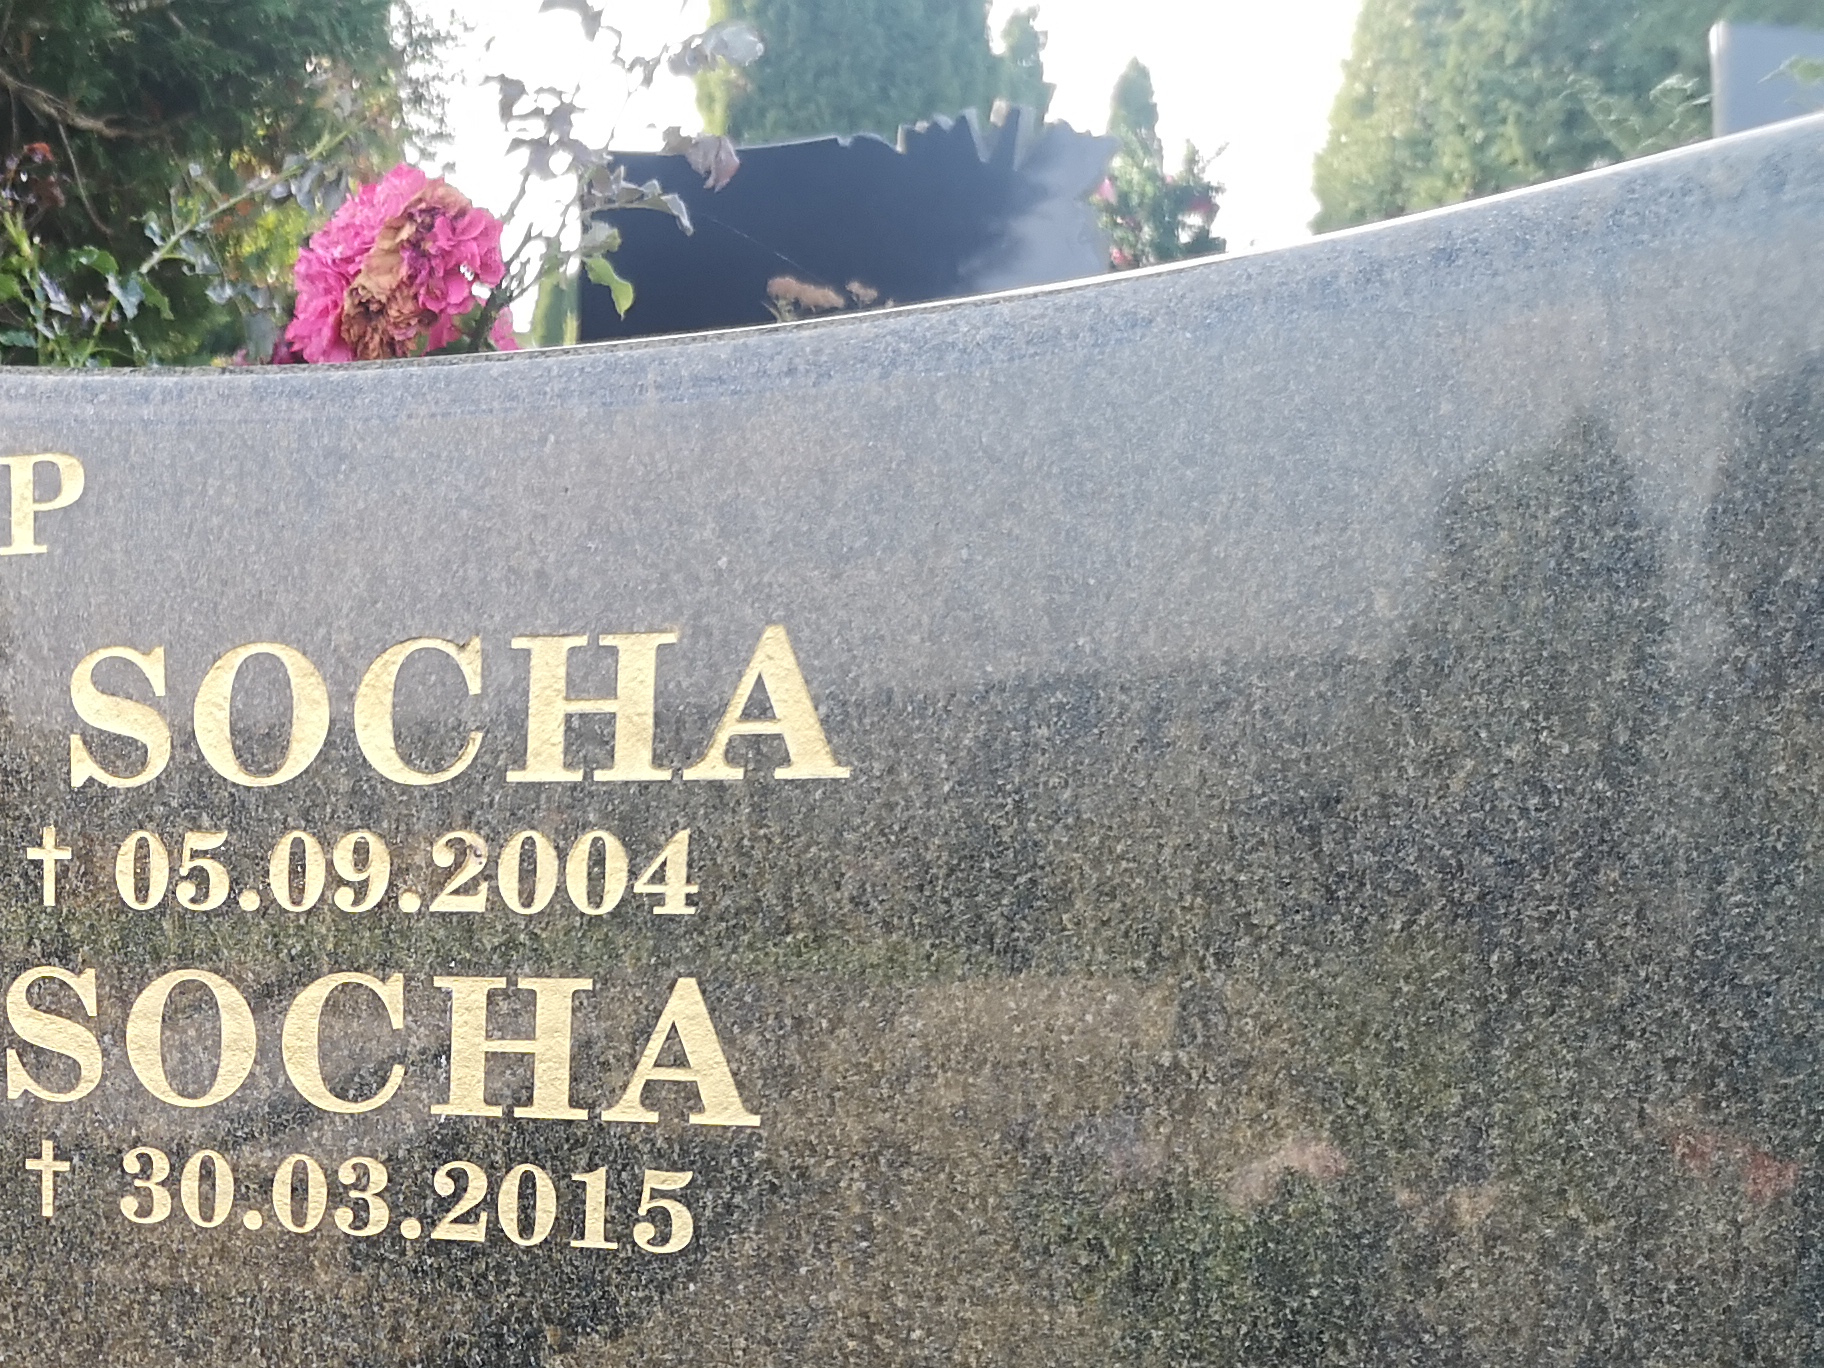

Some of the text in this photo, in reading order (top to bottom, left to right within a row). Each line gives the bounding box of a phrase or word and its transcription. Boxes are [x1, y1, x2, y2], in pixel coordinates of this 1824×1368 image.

[69, 624, 852, 788] SOCHA
[114, 827, 700, 916] 05.09.2004
[5, 965, 762, 1127] SOCHA
[120, 1147, 695, 1254] 30.03.2015
